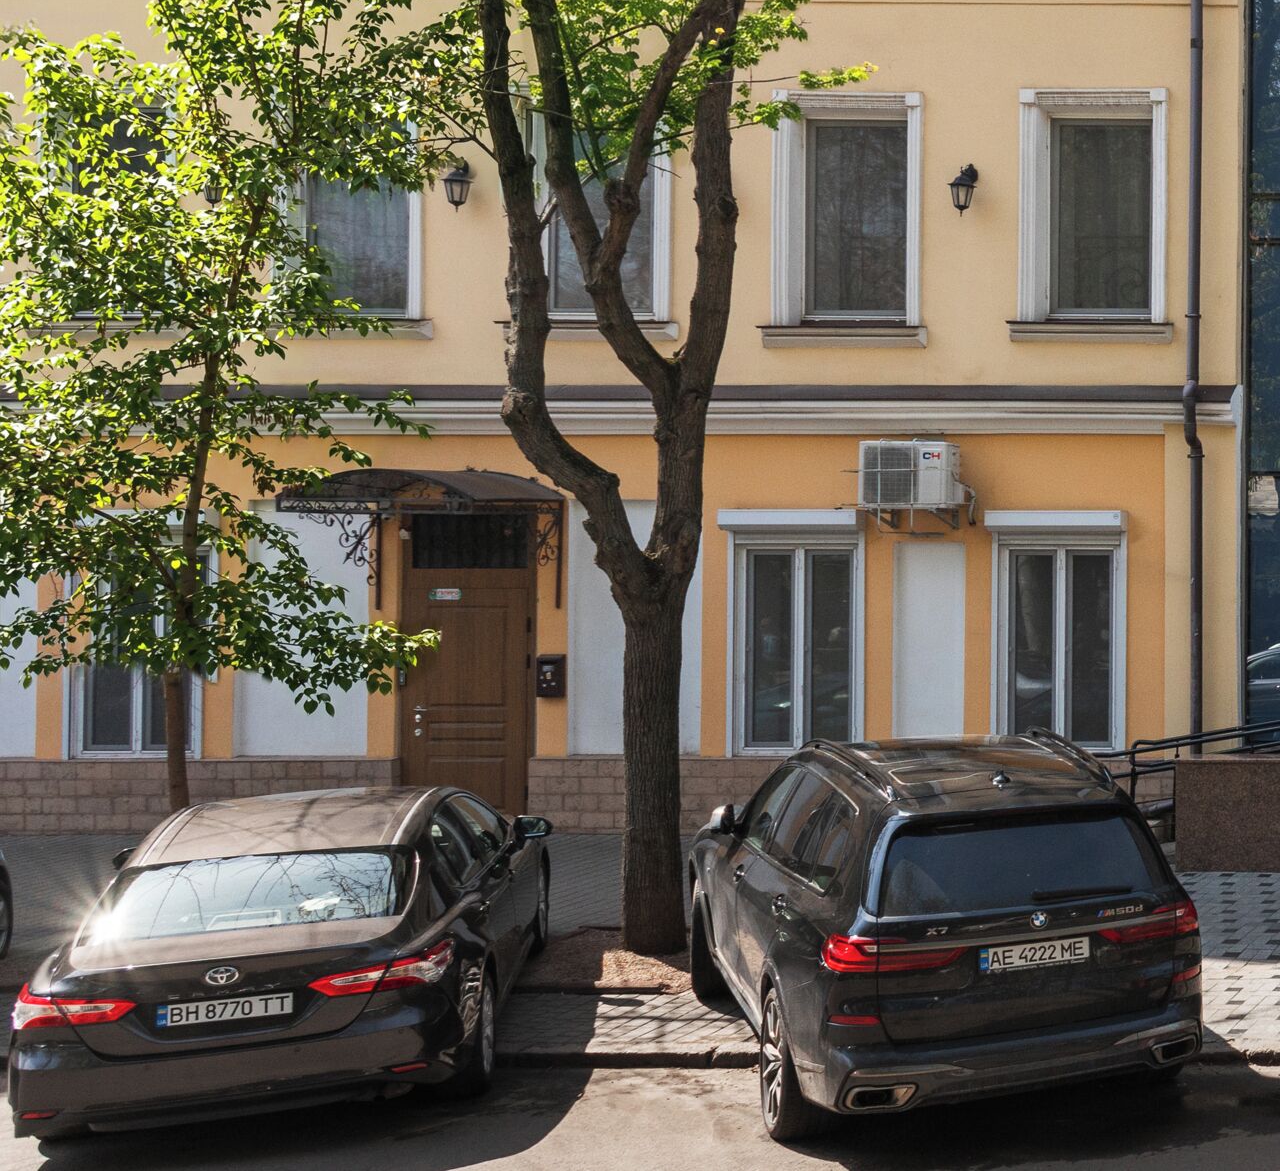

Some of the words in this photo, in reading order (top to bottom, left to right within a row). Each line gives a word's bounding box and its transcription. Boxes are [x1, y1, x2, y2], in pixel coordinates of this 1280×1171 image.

[922, 452, 941, 460] CH
[925, 926, 949, 936] X7
[990, 949, 1014, 968] AE
[1019, 944, 1057, 964] 4222
[1060, 940, 1084, 959] ME
[170, 1005, 199, 1024] BH
[205, 999, 253, 1020] 8770
[259, 995, 290, 1014] TT
